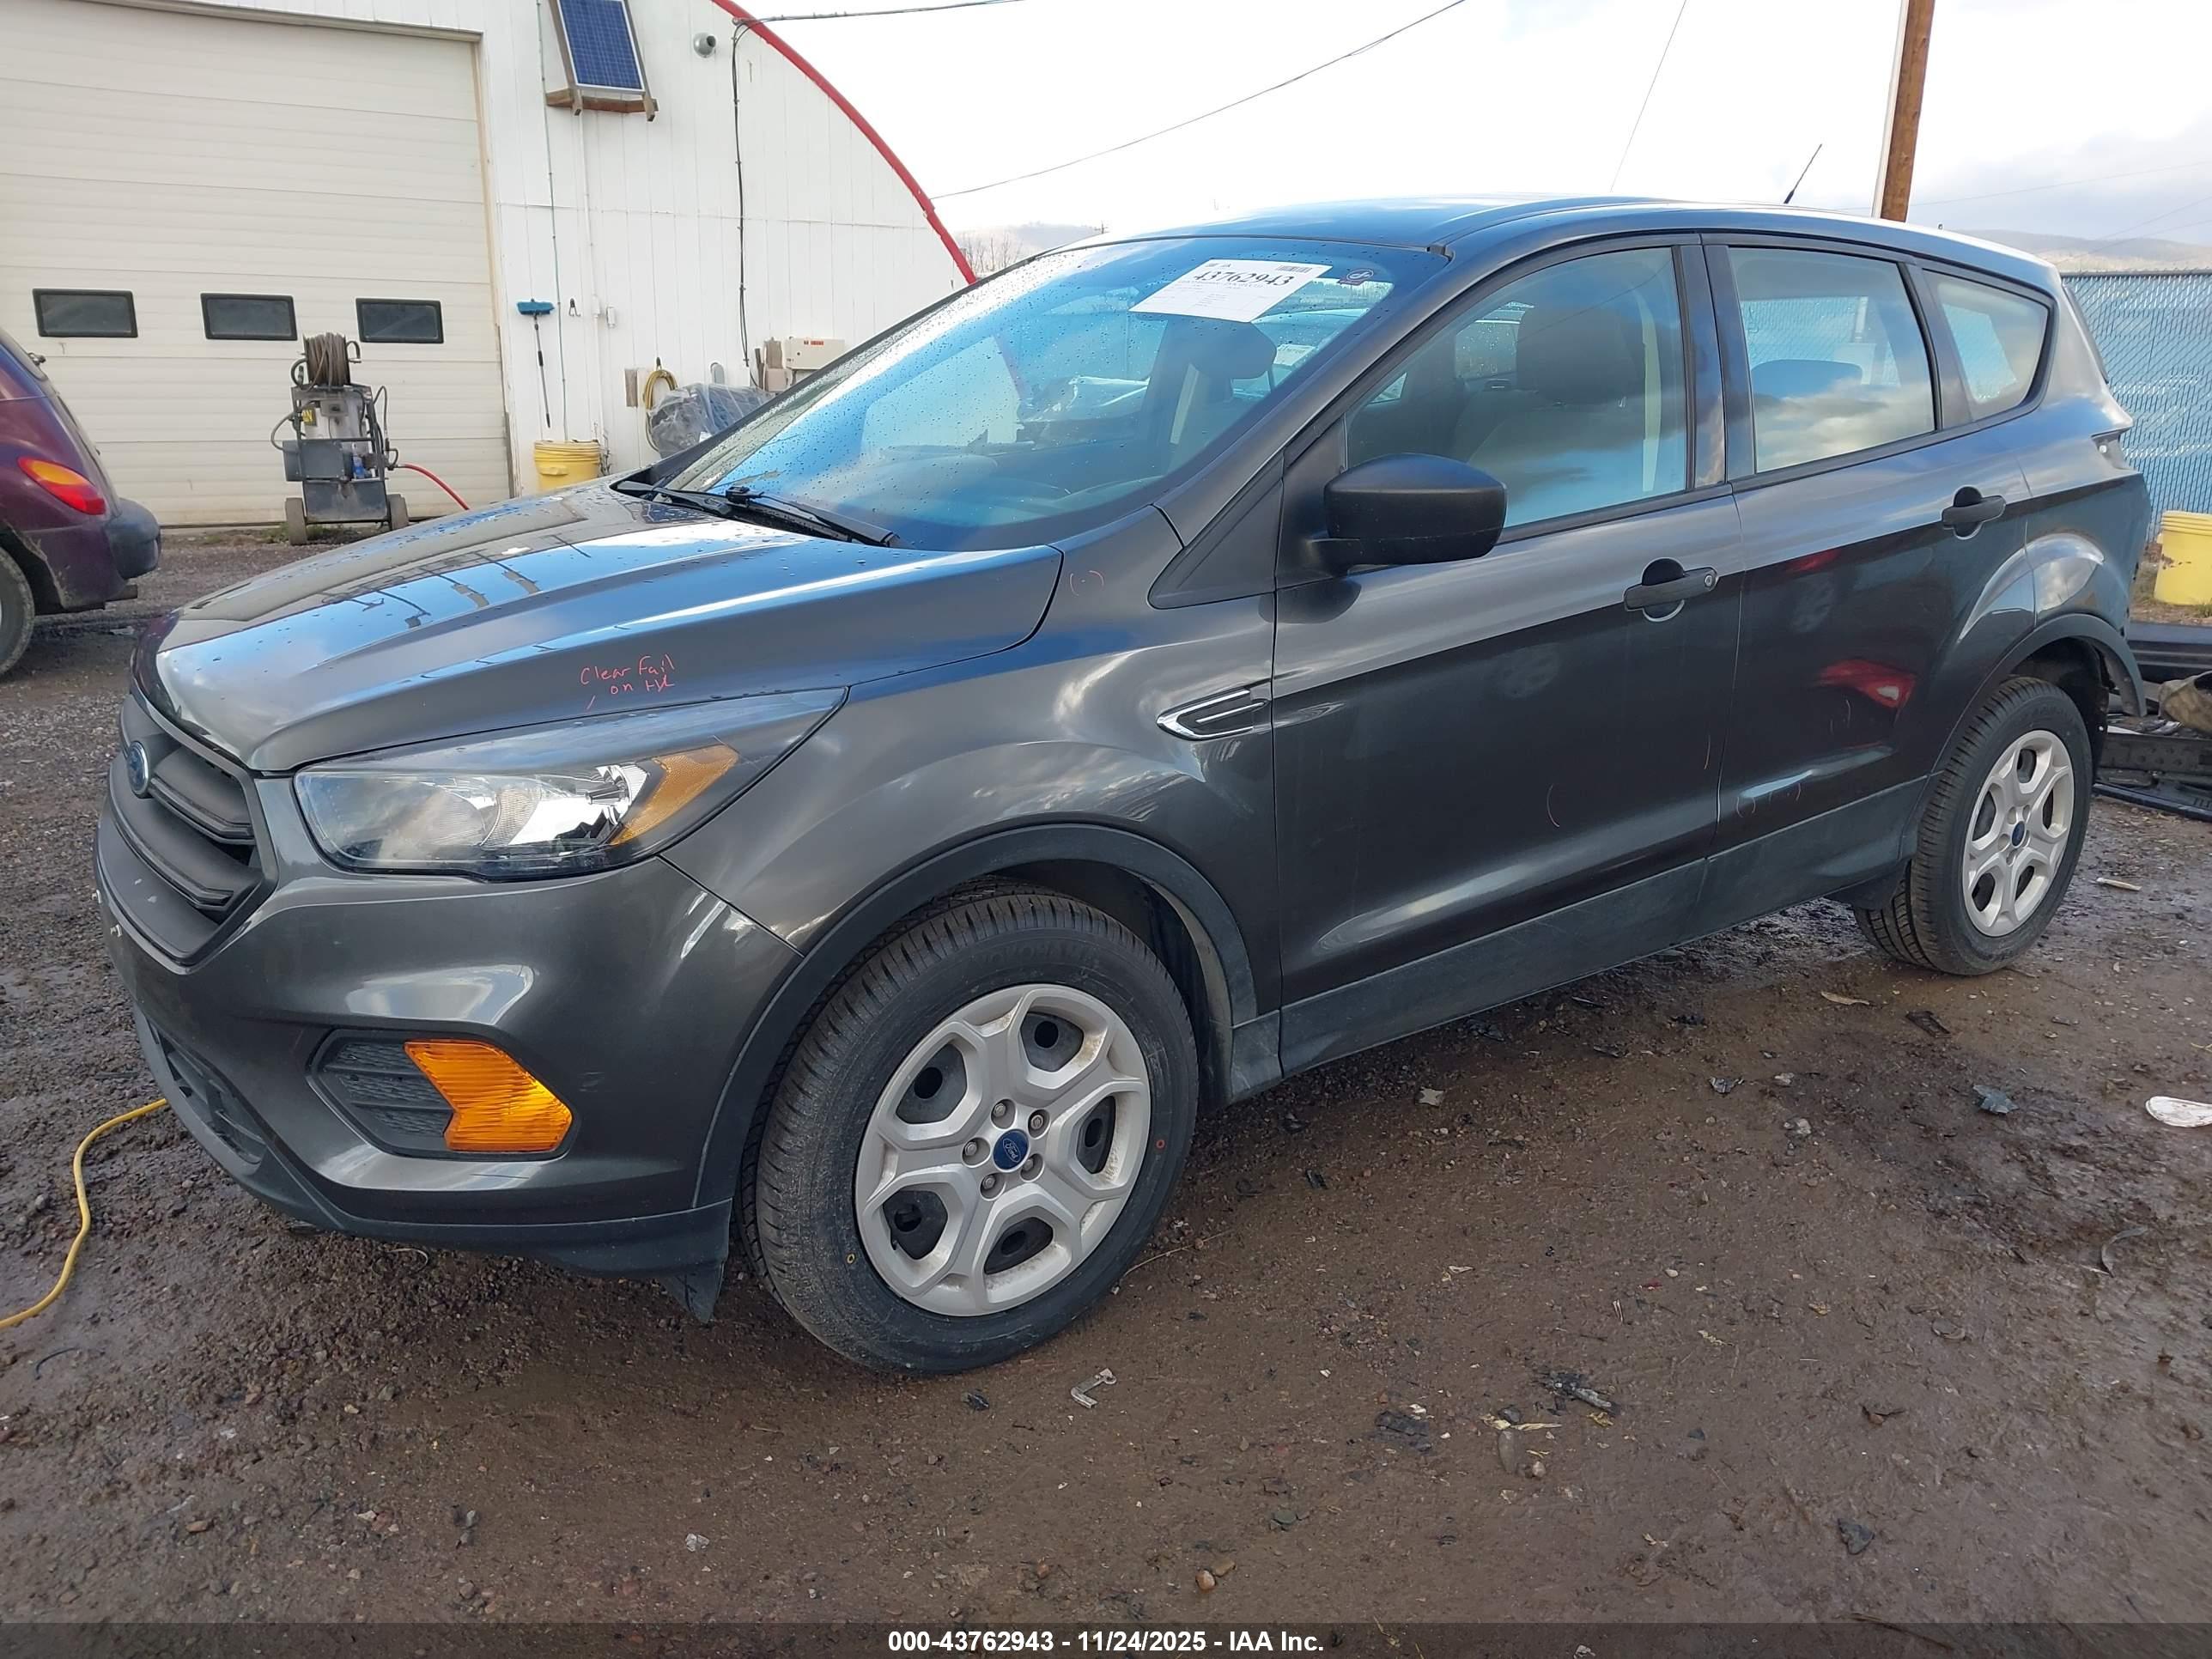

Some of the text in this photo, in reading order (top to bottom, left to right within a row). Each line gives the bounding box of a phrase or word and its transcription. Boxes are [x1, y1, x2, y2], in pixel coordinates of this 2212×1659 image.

[1194, 271, 1294, 286] 43762943
[580, 653, 675, 685] Clear Fail
[611, 683, 633, 695] on
